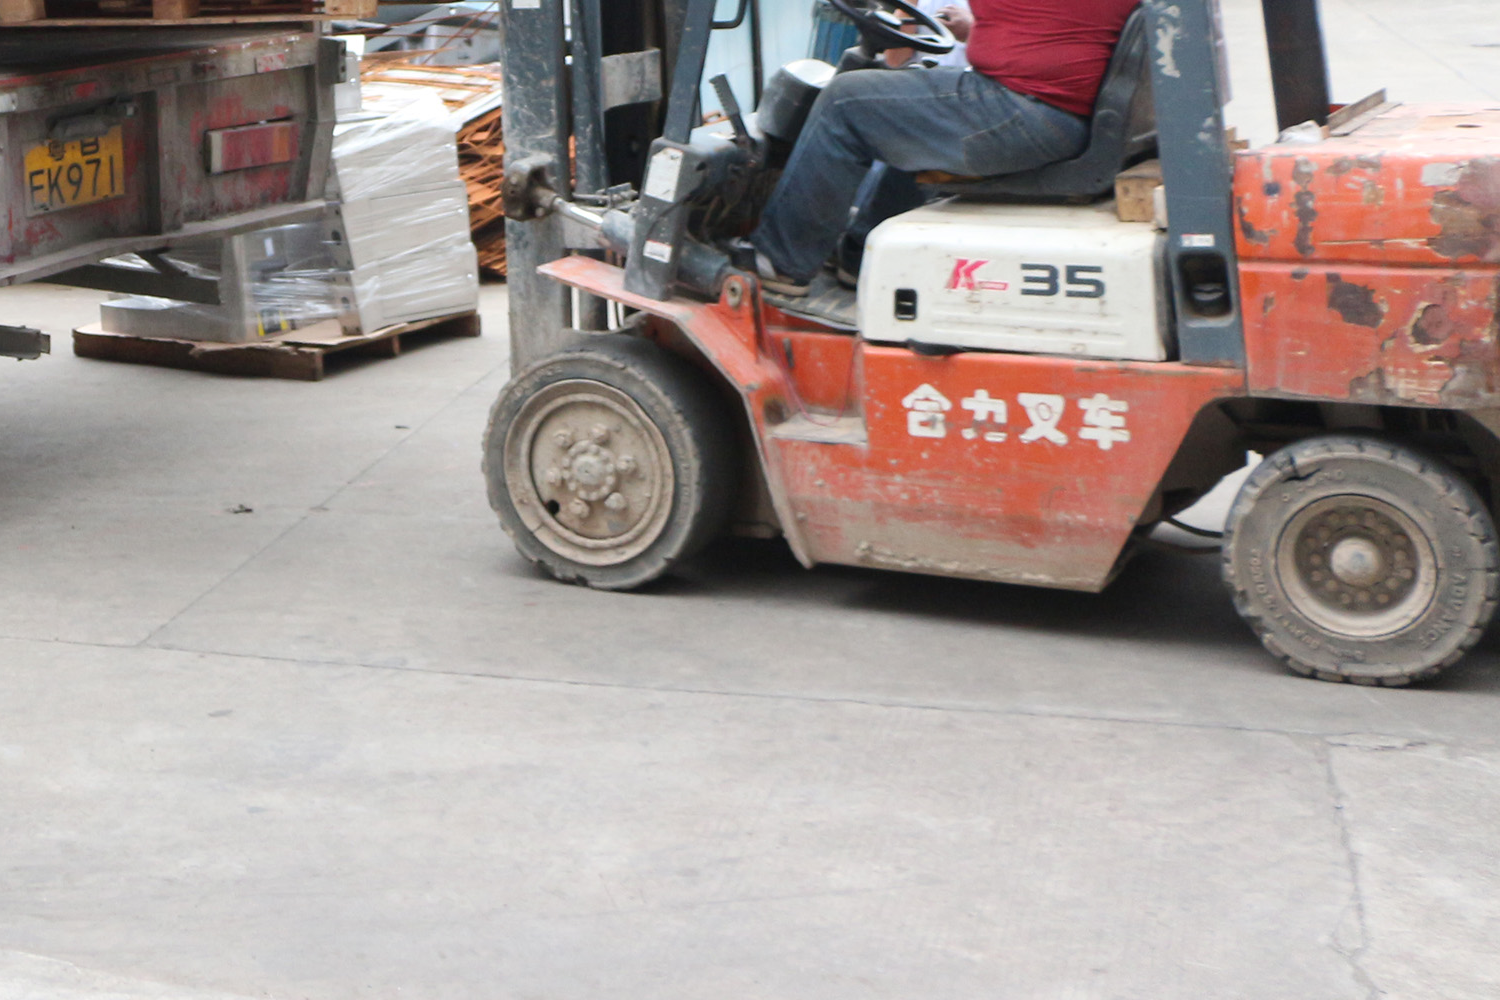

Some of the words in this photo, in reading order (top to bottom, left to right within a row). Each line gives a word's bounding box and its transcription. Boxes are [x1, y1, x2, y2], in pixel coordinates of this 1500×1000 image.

[946, 258, 989, 291] K
[1019, 263, 1106, 299] 35
[902, 383, 1132, 451] 合力叉车
